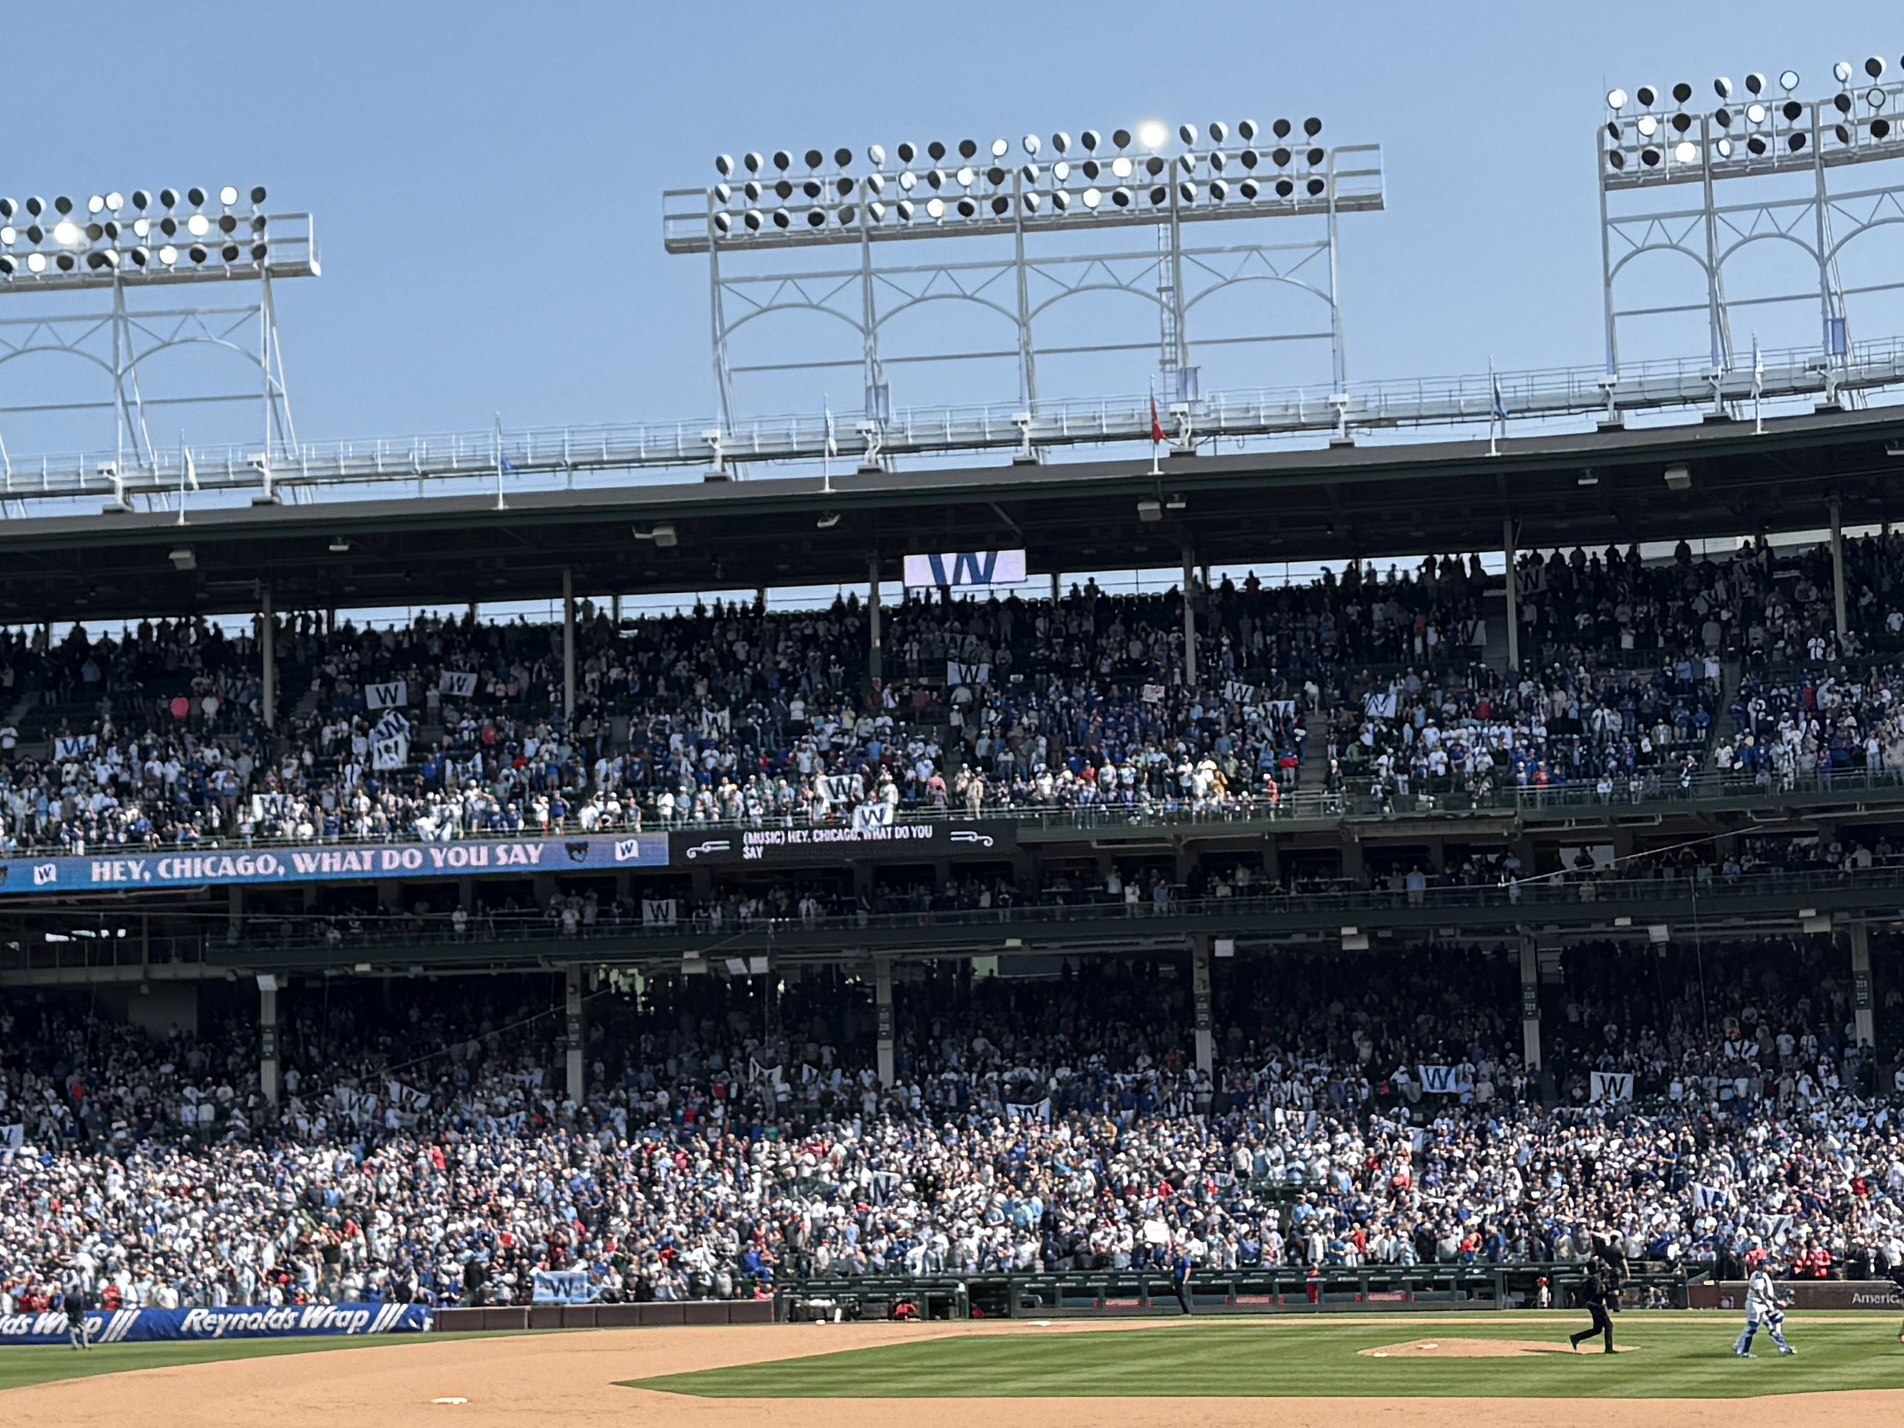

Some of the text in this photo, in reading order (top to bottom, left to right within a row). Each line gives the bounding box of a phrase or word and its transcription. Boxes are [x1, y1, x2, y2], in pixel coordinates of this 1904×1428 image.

[927, 551, 998, 586] W
[958, 664, 978, 684] W
[375, 685, 399, 705] W
[1231, 683, 1249, 702] W
[828, 776, 851, 800] W
[861, 807, 886, 825] W
[743, 830, 785, 845] (MUSIC)
[895, 827, 910, 839] DO
[911, 825, 933, 839] YOU
[620, 842, 635, 857] W
[743, 846, 763, 859] SAY
[38, 866, 53, 880] W
[91, 843, 545, 883] HEY, CHICAGO, WHAT DO YOU SAY
[649, 902, 669, 920] W
[1426, 1067, 1452, 1090] W
[1599, 1075, 1626, 1098] W
[551, 1279, 574, 1298] W
[181, 1304, 368, 1339] Reynolds Wrap
